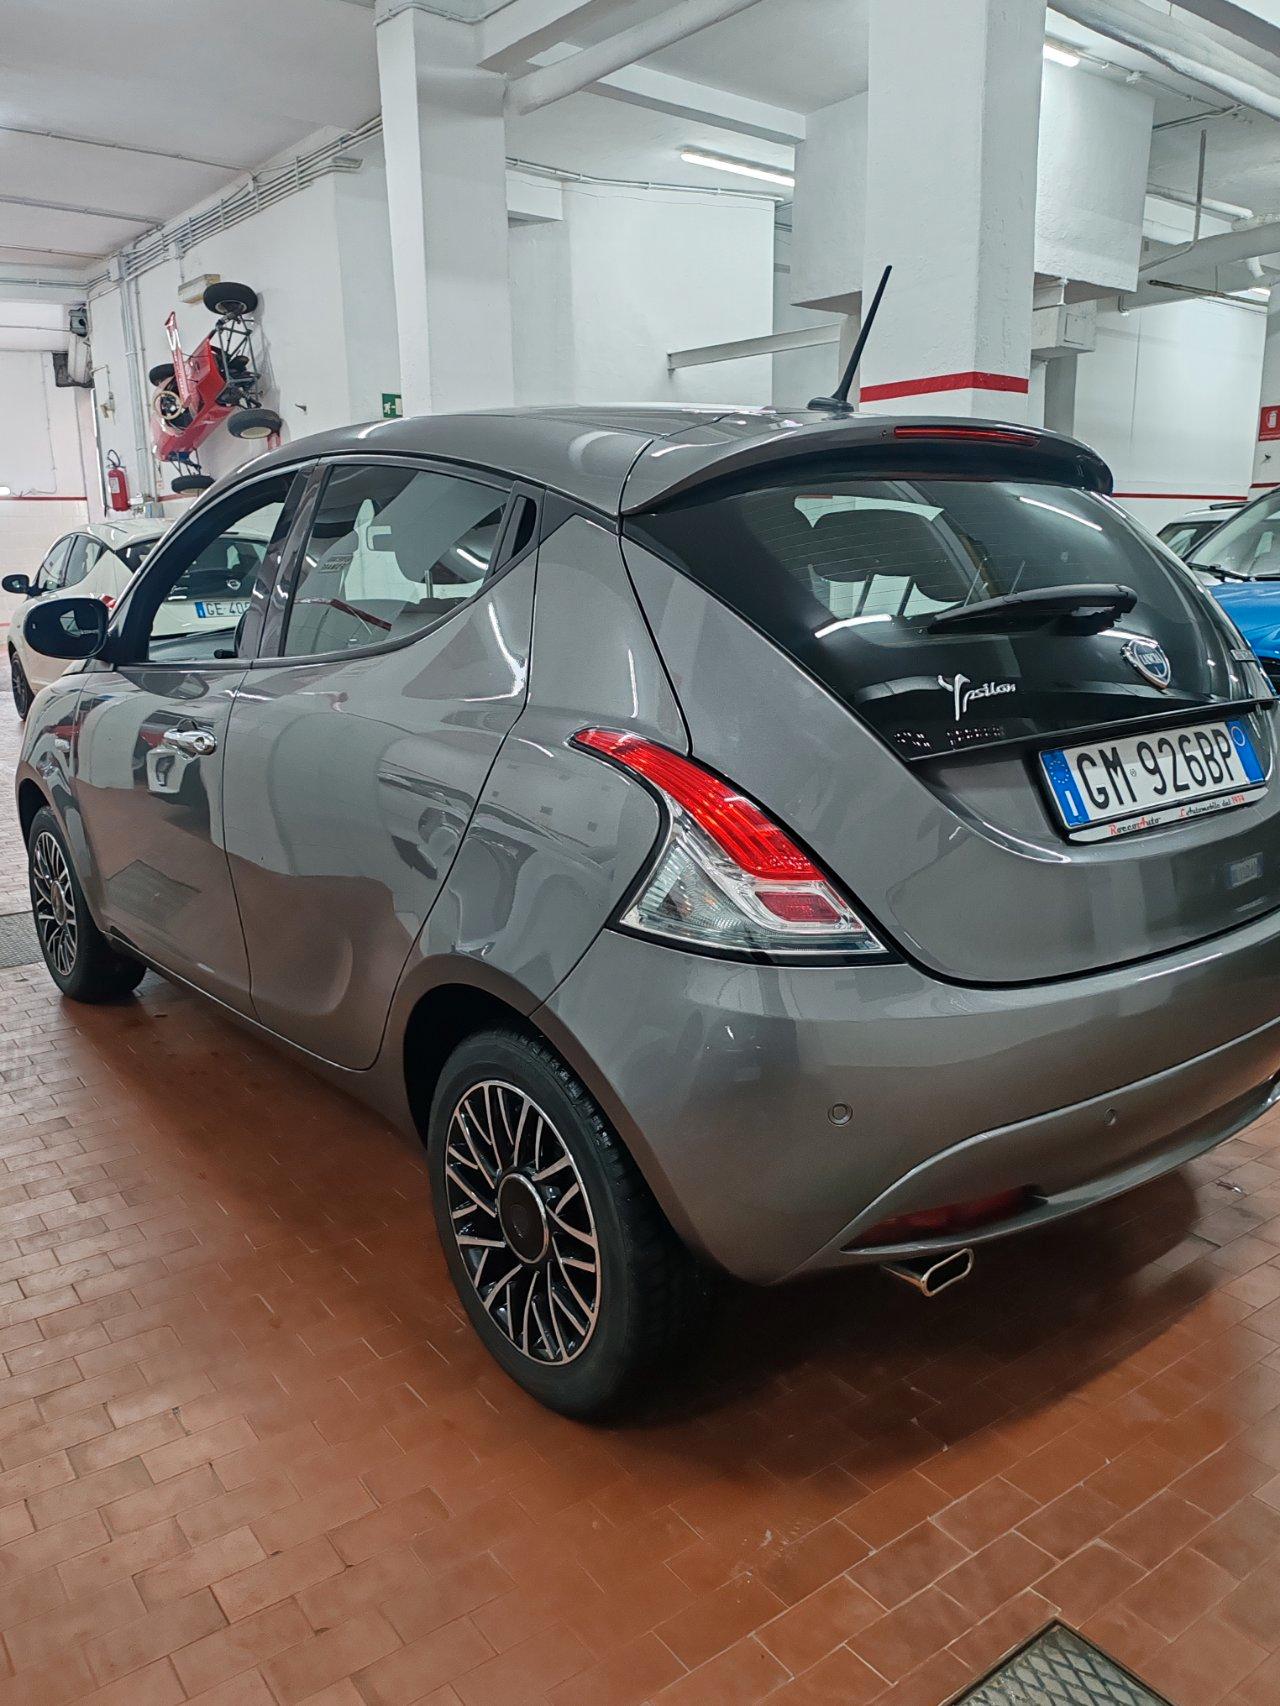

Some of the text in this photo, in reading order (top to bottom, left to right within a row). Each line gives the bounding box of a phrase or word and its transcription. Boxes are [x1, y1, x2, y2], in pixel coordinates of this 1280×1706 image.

[206, 602, 224, 616] GE
[938, 674, 1016, 721] Ypsilon
[1076, 728, 1234, 810] GM 926BP
